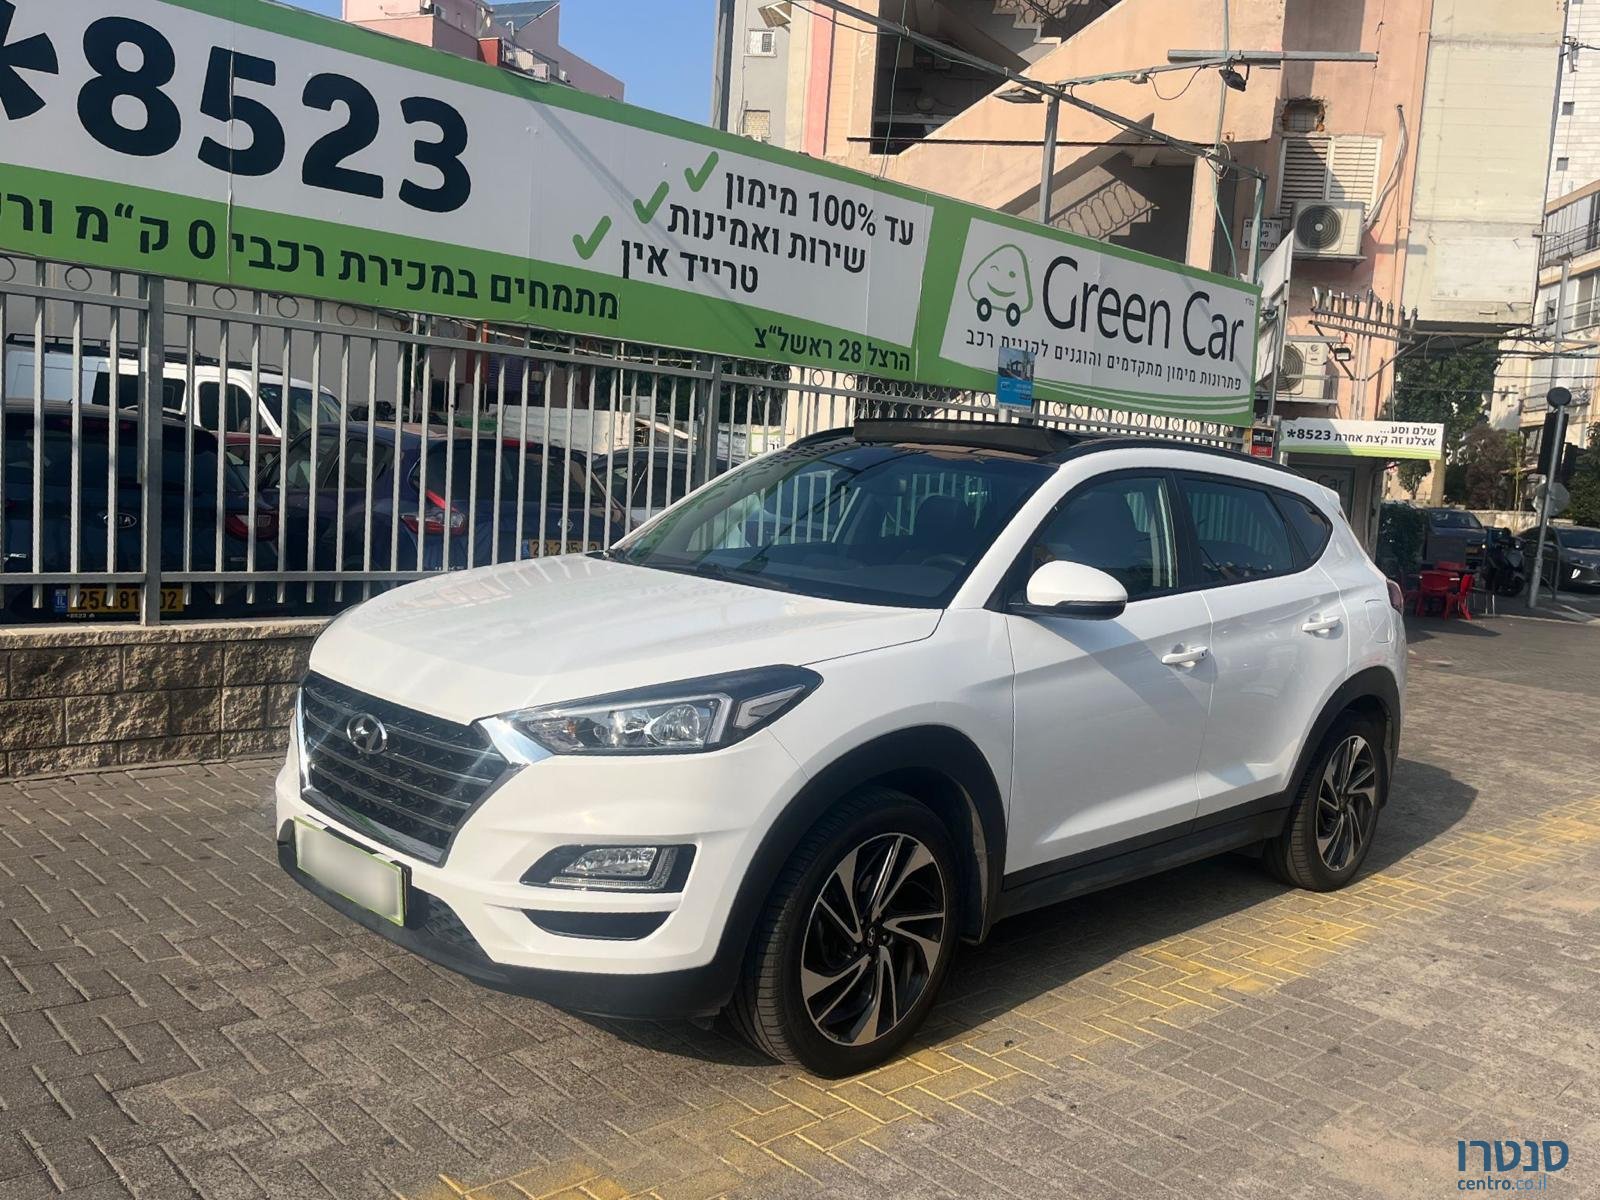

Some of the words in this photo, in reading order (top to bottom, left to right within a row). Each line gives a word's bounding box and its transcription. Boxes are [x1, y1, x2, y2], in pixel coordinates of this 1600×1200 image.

[726, 172, 797, 217] מימון
[809, 191, 876, 236] 100%
[188, 219, 215, 260] 0
[668, 204, 779, 255] ואמינות
[884, 215, 914, 246] עד
[233, 235, 325, 277] רכבי
[621, 240, 669, 279] אין
[788, 233, 865, 273] שירות
[339, 249, 478, 299] במכירת
[680, 252, 758, 293] טרייד
[490, 275, 618, 319] מתמחים
[1043, 256, 1171, 349] Green
[1183, 291, 1244, 362] Car
[839, 339, 861, 364] 28
[966, 329, 993, 348] רכב
[868, 343, 910, 372] הרצל
[1055, 345, 1101, 367] והוגנים
[1107, 355, 1162, 378] מתקדמים
[1167, 365, 1196, 382] מימון
[1200, 371, 1241, 390] פתרונות
[1334, 434, 1362, 443] אחרת
[1366, 435, 1387, 447] קצת
[1391, 436, 1403, 445] זה
[1406, 438, 1435, 446] אצלנו
[1413, 426, 1437, 435] שלם
